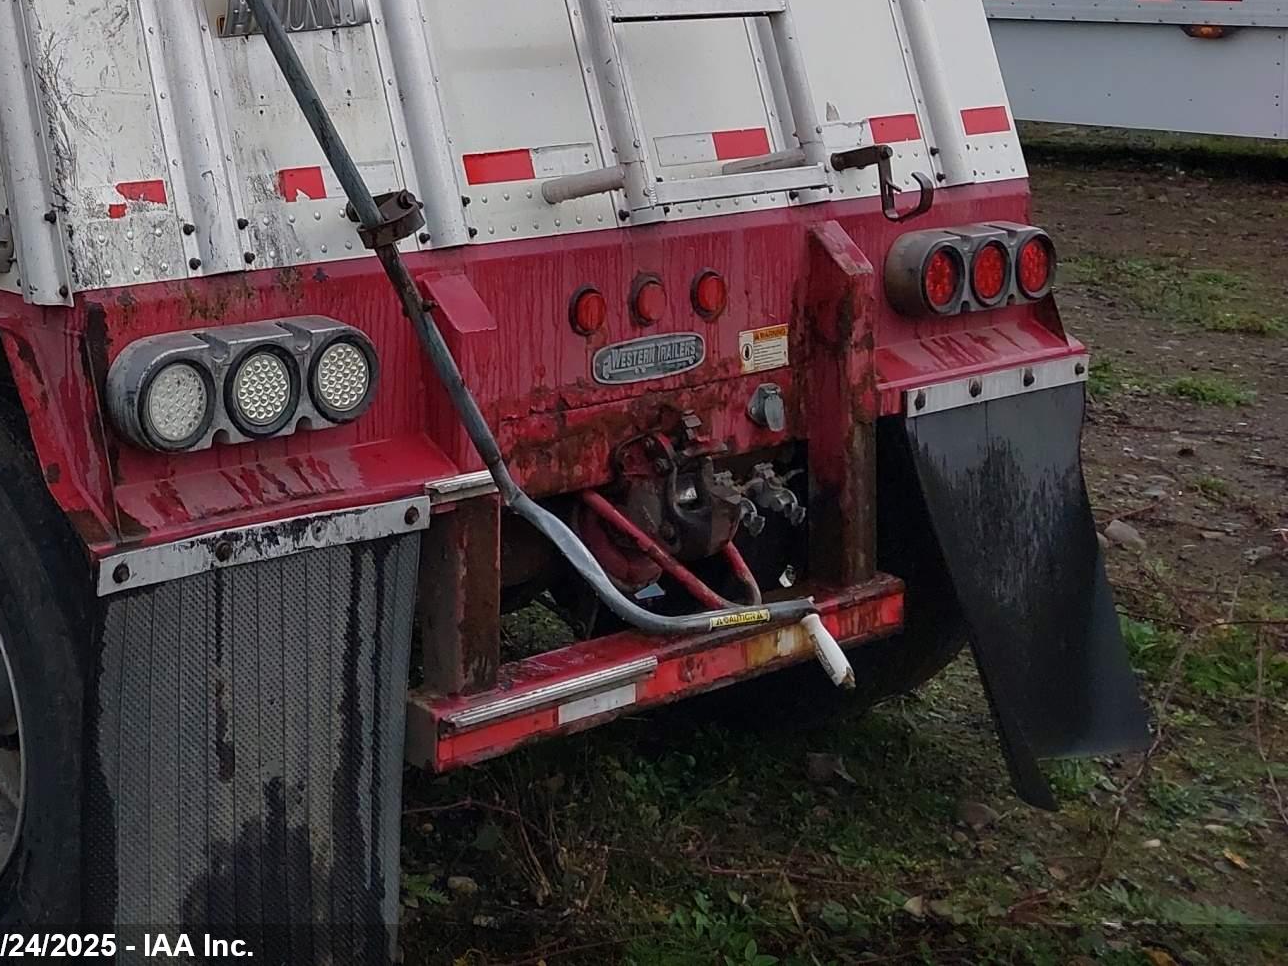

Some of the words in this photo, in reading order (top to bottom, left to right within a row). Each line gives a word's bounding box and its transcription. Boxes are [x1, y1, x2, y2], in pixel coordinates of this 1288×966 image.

[610, 345, 656, 369] WESTERN
[656, 340, 696, 362] TRAILERS
[722, 613, 756, 624] CAUTION
